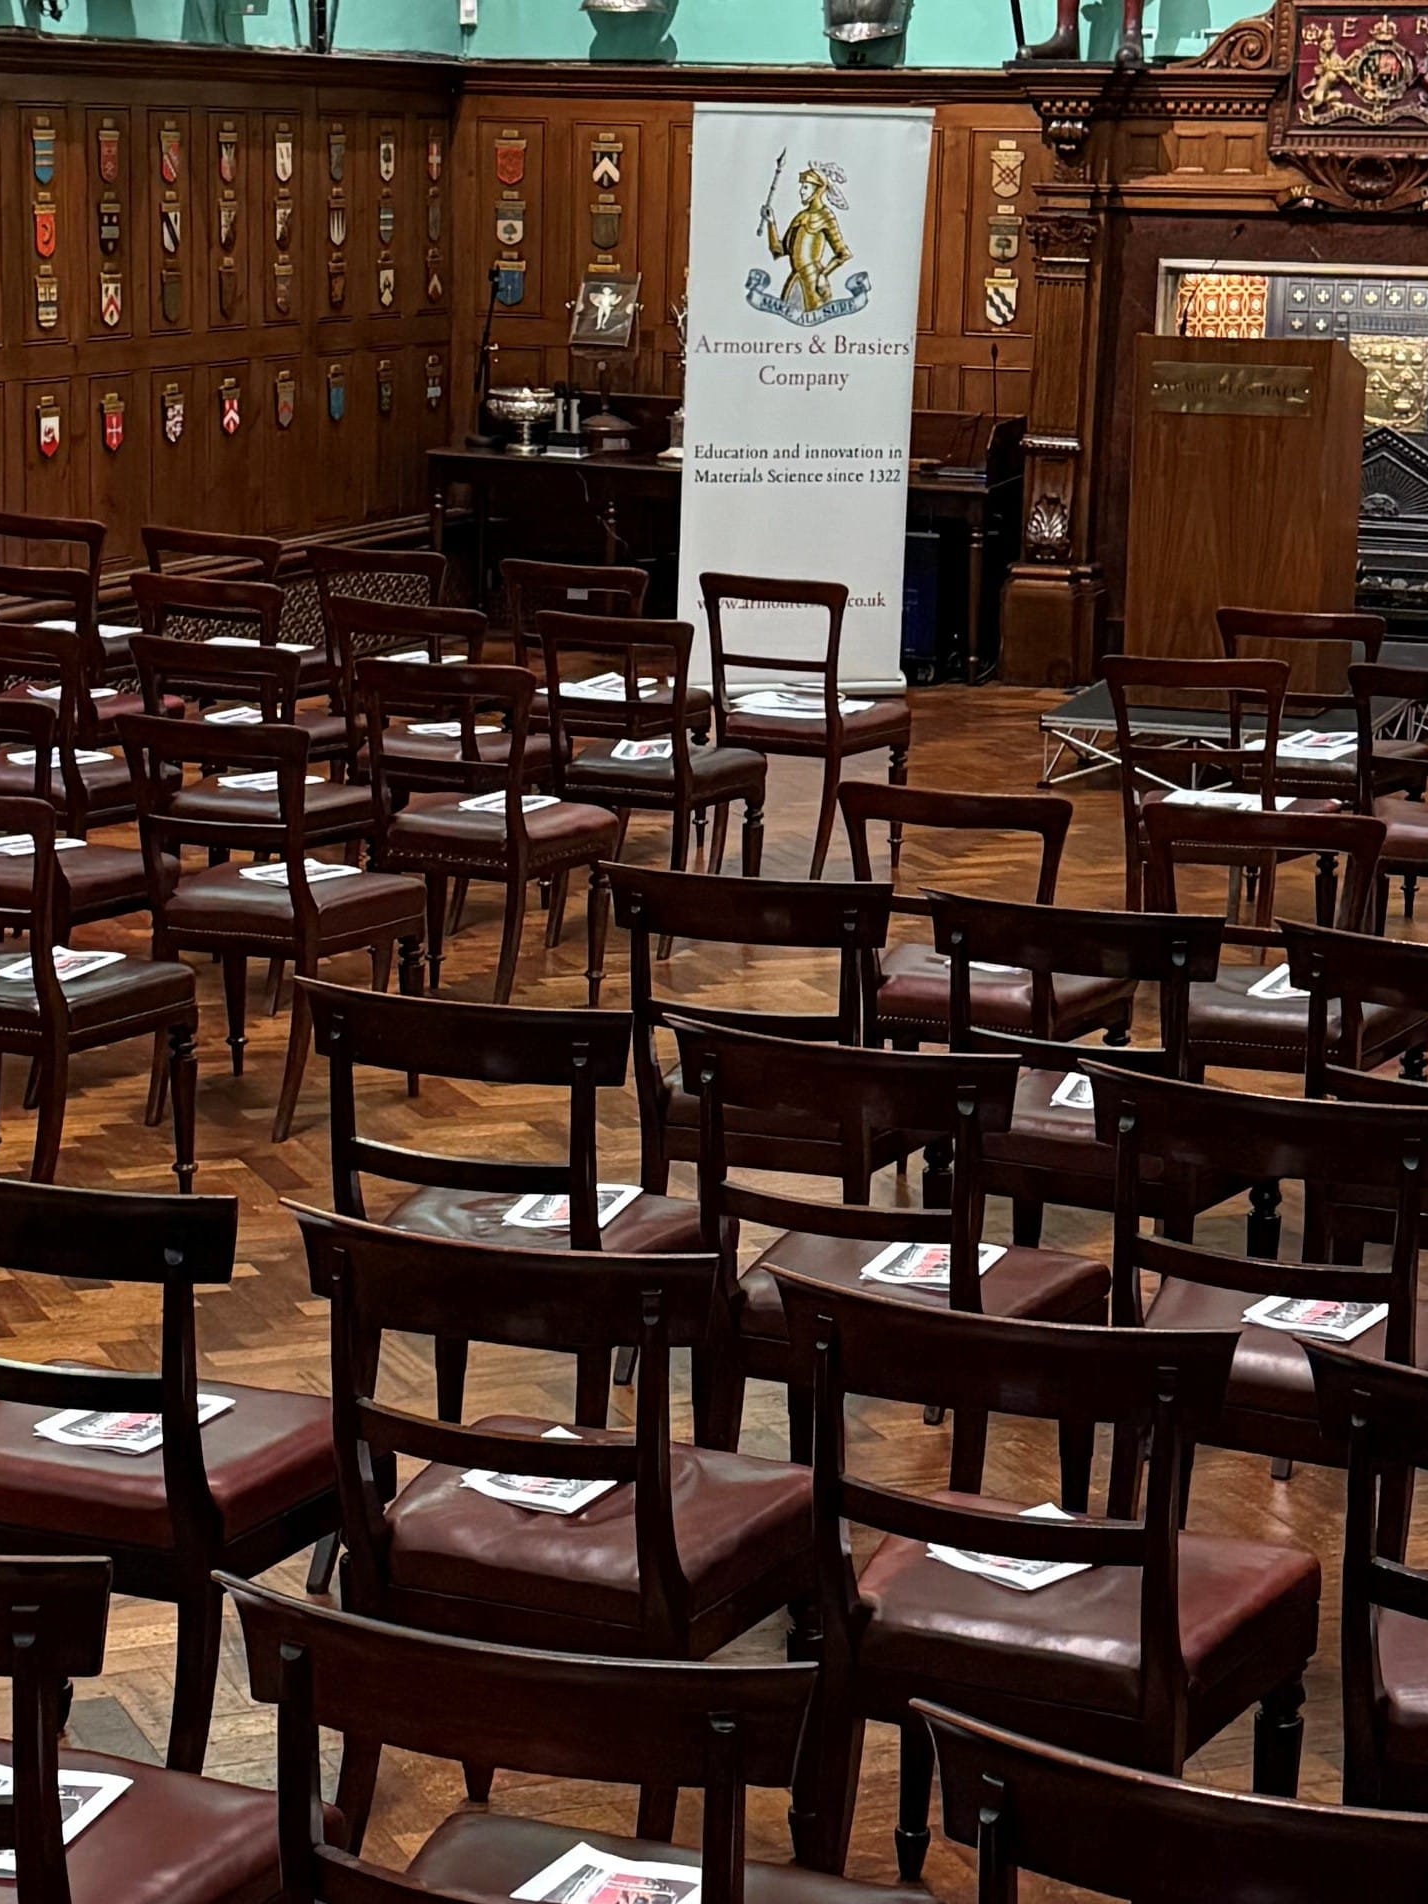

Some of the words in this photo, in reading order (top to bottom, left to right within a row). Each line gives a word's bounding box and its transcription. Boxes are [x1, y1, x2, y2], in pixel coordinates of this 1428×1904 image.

[1342, 17, 1358, 38] E
[759, 296, 794, 318] MAKE
[796, 309, 822, 324] ALL
[822, 299, 857, 318] SURE
[694, 334, 803, 355] Armourers
[808, 335, 827, 354] &
[758, 364, 850, 391] Company
[694, 443, 768, 460] Education
[772, 442, 801, 460] and
[804, 443, 884, 460] innovation
[888, 444, 903, 459] in
[694, 467, 764, 484] Materials
[767, 468, 823, 484] Science
[826, 468, 864, 484] since
[869, 468, 901, 483] 1322
